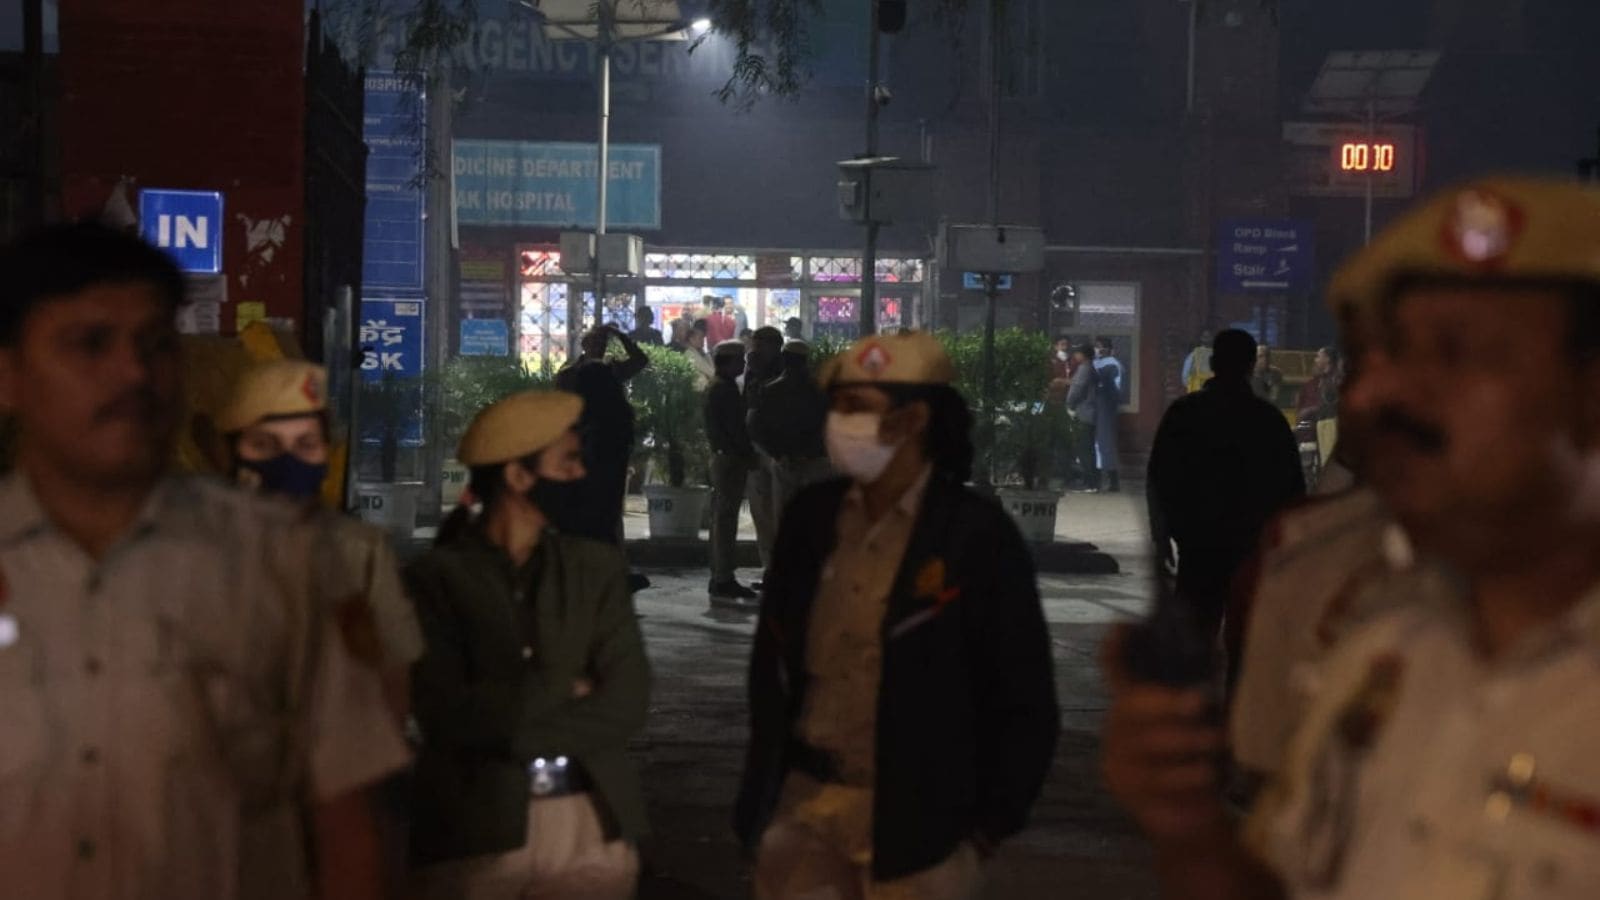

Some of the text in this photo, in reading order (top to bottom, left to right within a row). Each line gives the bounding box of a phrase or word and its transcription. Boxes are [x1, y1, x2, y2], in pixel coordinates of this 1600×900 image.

[454, 157, 517, 177] DICINE
[486, 190, 575, 212] HOSPITAL
[157, 214, 208, 249] IN
[1234, 227, 1261, 239] OPD
[1232, 242, 1267, 255] Ramp
[1232, 263, 1265, 277] Stair
[360, 351, 404, 370] SK
